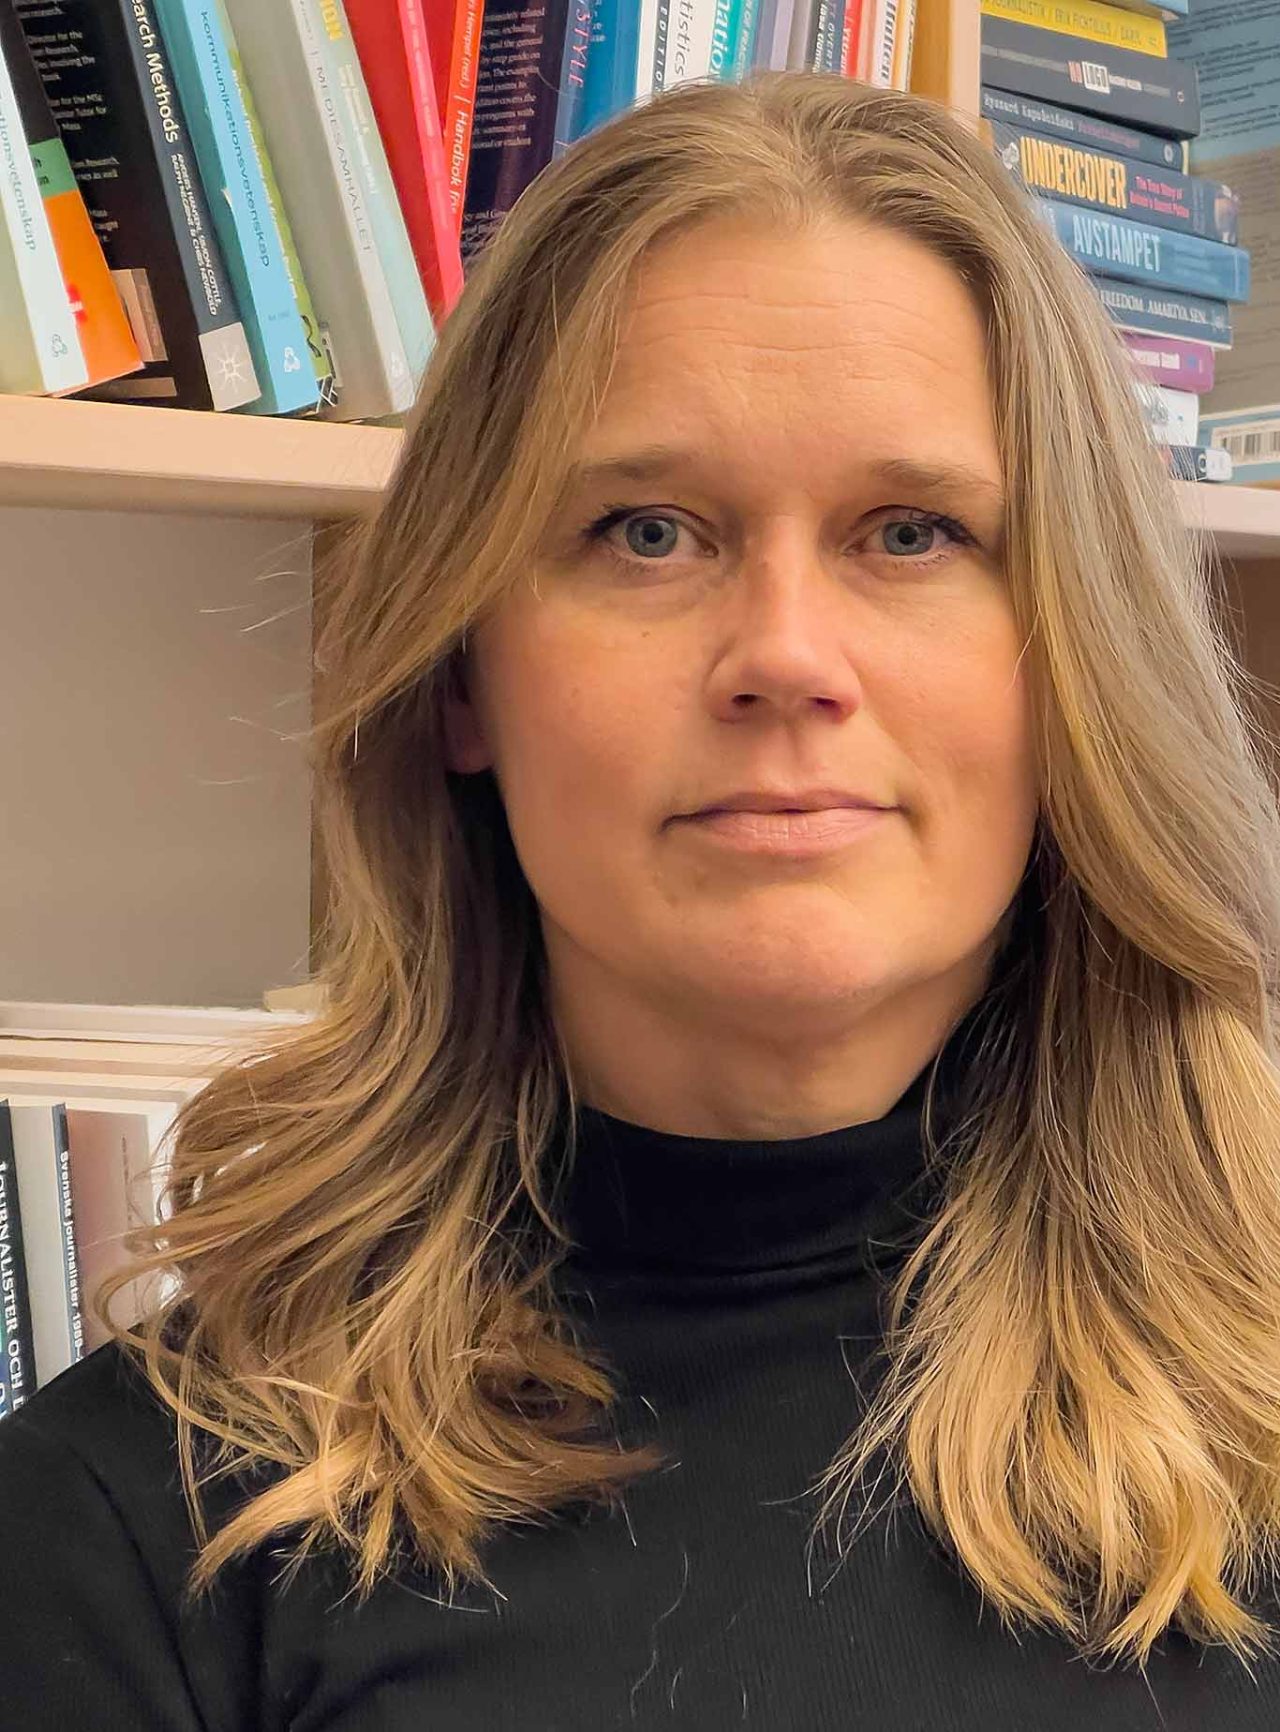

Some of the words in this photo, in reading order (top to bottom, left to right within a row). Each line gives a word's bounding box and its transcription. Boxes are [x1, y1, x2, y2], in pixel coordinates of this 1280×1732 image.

[655, 6, 668, 91] EDITIO
[146, 53, 180, 143] Methods
[450, 111, 469, 186] Handbok
[1020, 135, 1127, 209] UNDERCOVER
[1072, 214, 1161, 272] AVSTAMPET
[60, 1150, 72, 1218] Svenska
[63, 1220, 80, 1308] journalister
[7, 1338, 25, 1389] OCH
